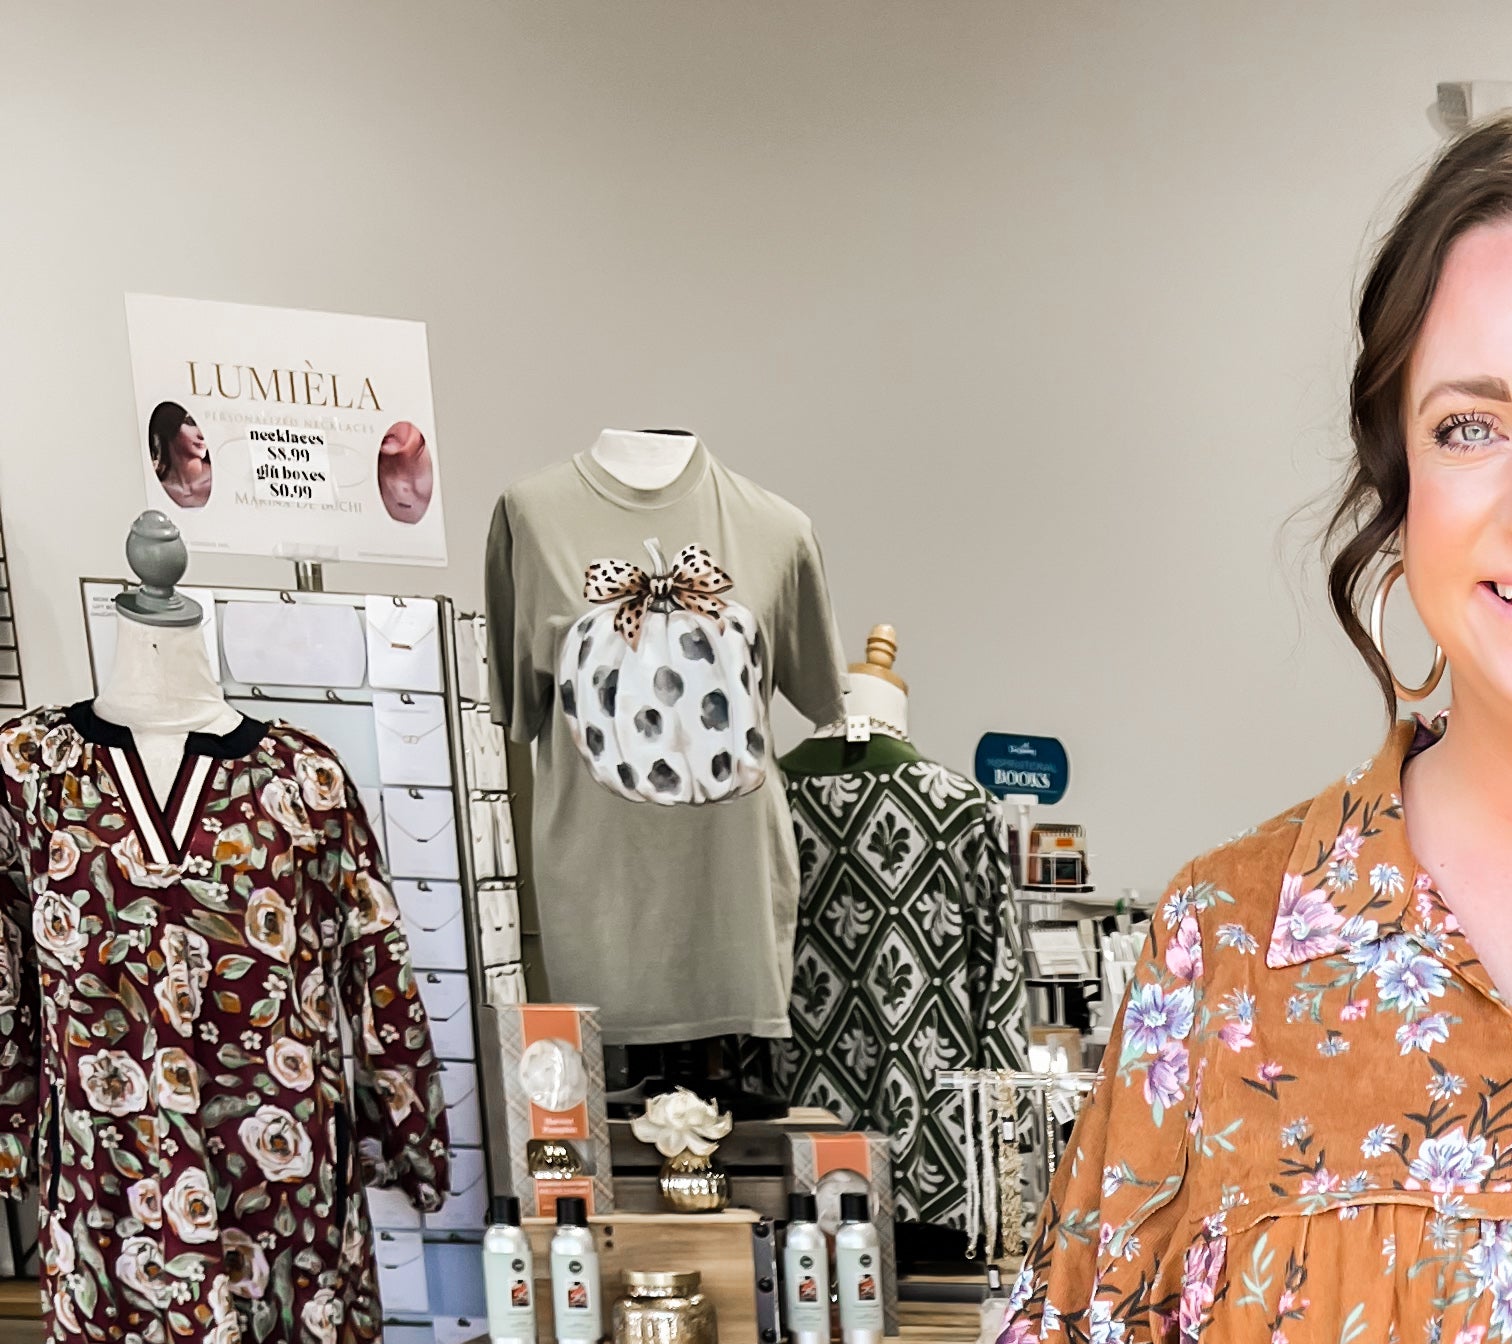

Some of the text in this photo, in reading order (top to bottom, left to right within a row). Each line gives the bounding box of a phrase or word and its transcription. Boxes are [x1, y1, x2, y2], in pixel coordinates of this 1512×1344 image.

[186, 360, 384, 411] LUMIÈLA
[250, 428, 324, 445] necklaces
[267, 446, 311, 462] $8.99
[256, 463, 326, 482] gift boxes
[269, 483, 313, 499] $0.99
[993, 768, 1051, 789] BOOKS
